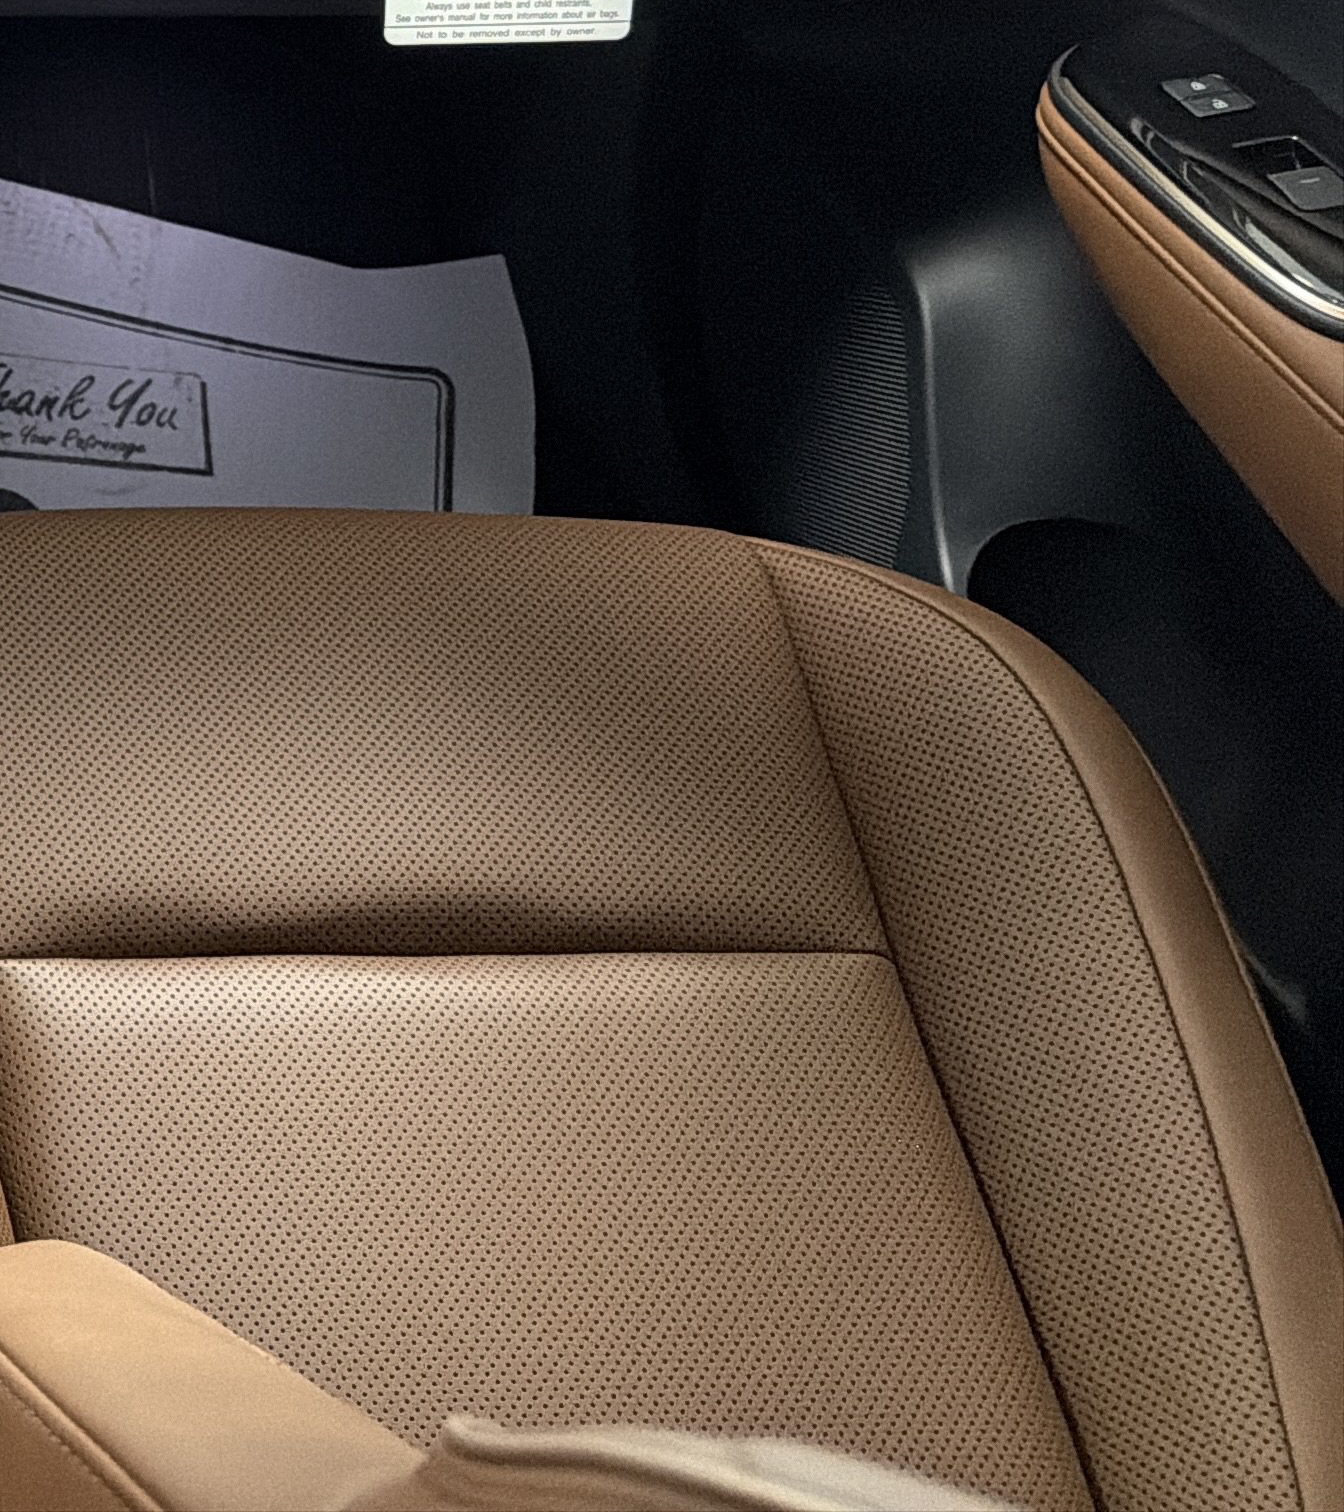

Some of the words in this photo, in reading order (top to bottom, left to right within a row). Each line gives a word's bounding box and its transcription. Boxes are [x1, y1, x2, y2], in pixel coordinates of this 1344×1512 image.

[395, 14, 411, 23] See
[416, 31, 433, 39] Not
[469, 29, 510, 38] removed
[514, 29, 545, 37] except
[550, 28, 561, 37] by
[108, 378, 178, 430] You
[19, 425, 56, 446] Your
[62, 428, 146, 459] Patronage
